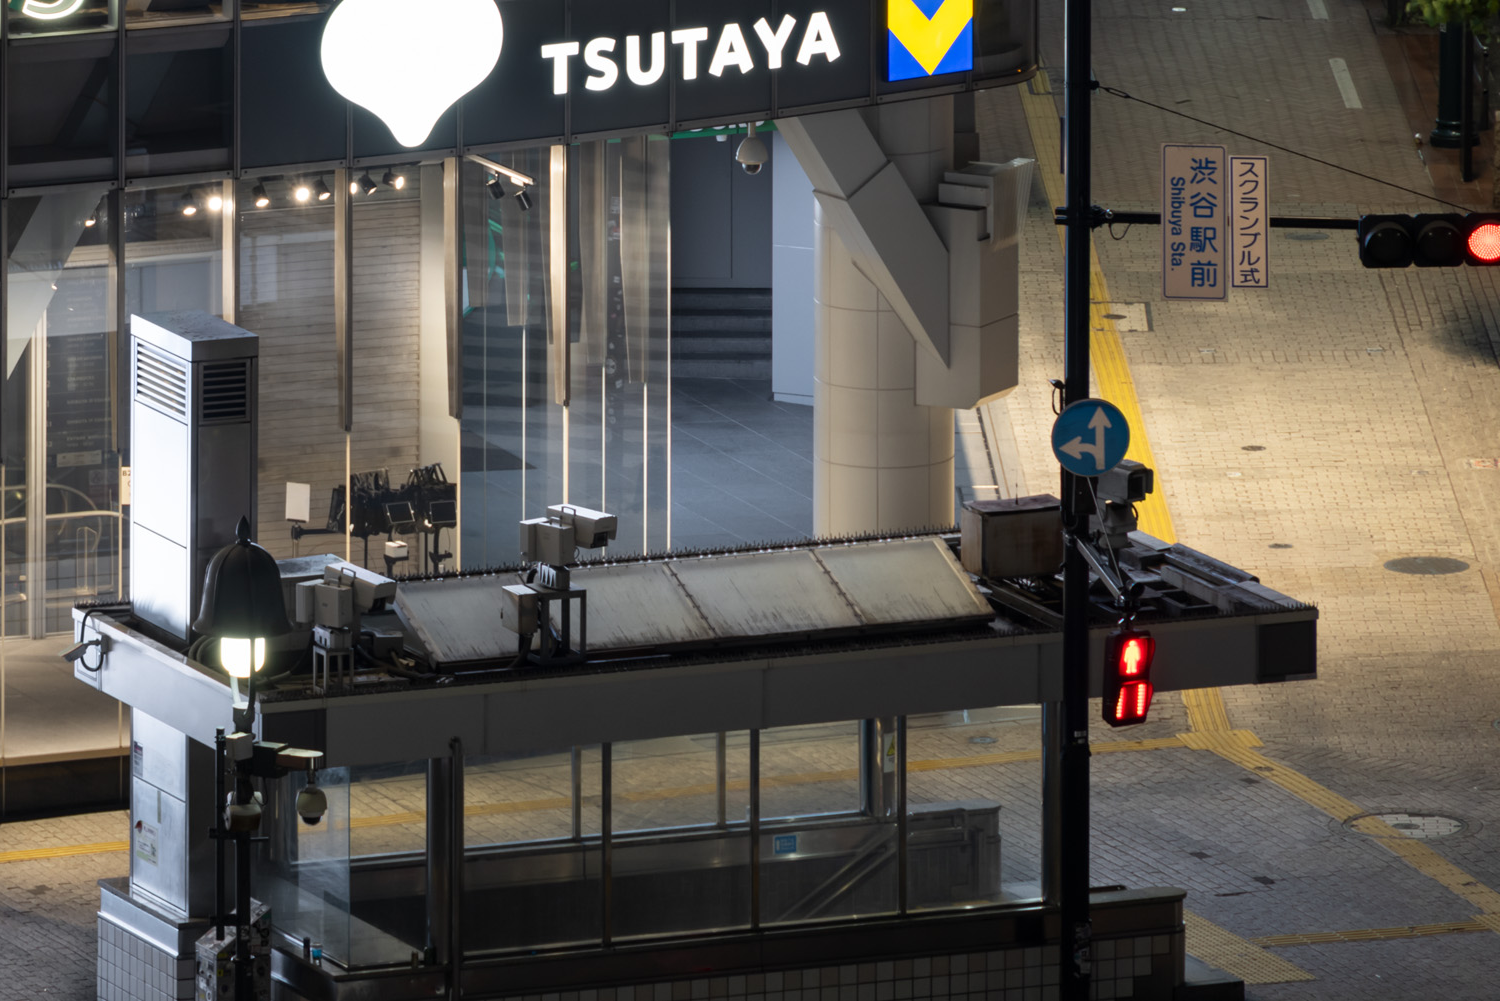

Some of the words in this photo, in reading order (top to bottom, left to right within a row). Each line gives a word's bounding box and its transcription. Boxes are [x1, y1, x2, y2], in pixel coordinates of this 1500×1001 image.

[541, 11, 841, 95] TSUTAYA
[1168, 176, 1186, 236] Shibuya
[1189, 157, 1218, 288] 渋谷駅前
[1239, 161, 1262, 284] スクランブル式
[1171, 241, 1186, 271] Sta.
